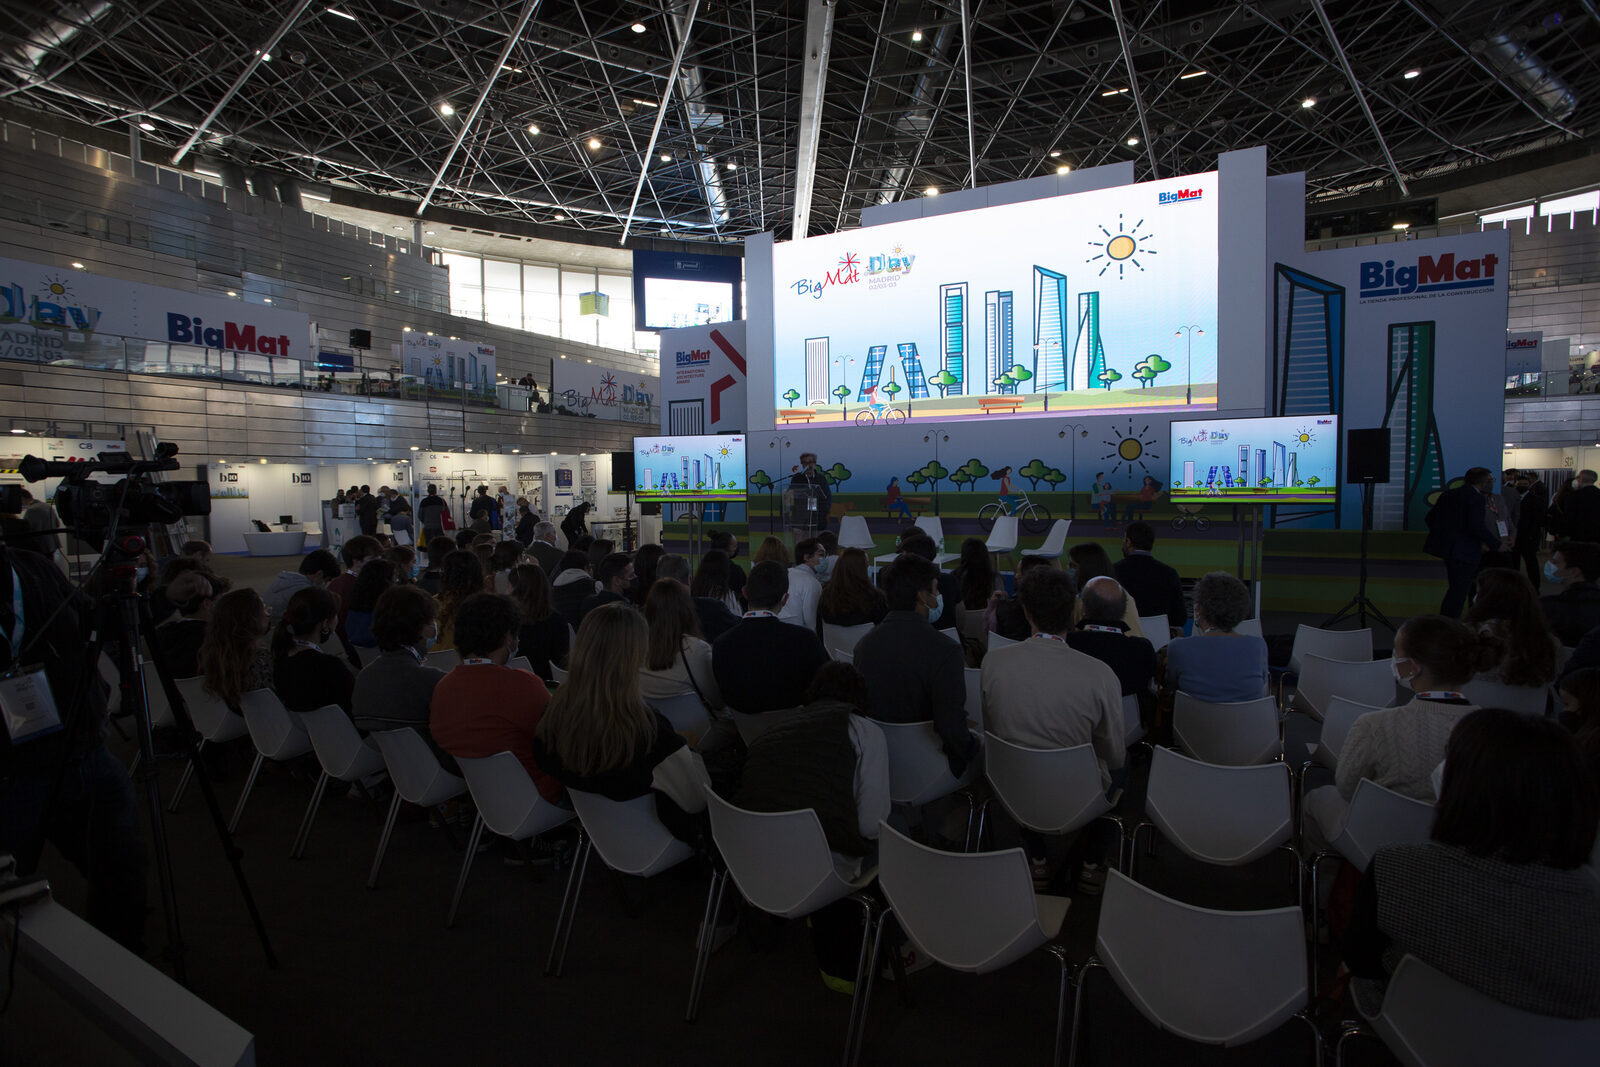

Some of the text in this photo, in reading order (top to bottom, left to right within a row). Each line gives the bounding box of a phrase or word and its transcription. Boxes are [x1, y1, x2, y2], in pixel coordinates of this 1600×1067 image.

[1158, 188, 1203, 202] BigMat
[790, 253, 916, 299] BigMat Day
[868, 275, 901, 285] MADRID
[1360, 253, 1498, 294] BigMat
[1388, 294, 1427, 302] PROFESIONAL
[1447, 288, 1495, 297] CONSTRUCCIÓN
[0, 331, 63, 349] ADRID
[167, 312, 290, 356] BigMat
[1506, 339, 1538, 349] igMat
[676, 349, 710, 364] BigMat
[561, 387, 617, 416] BigMat
[1179, 434, 1208, 446] BigMat
[1211, 431, 1230, 440] Day
